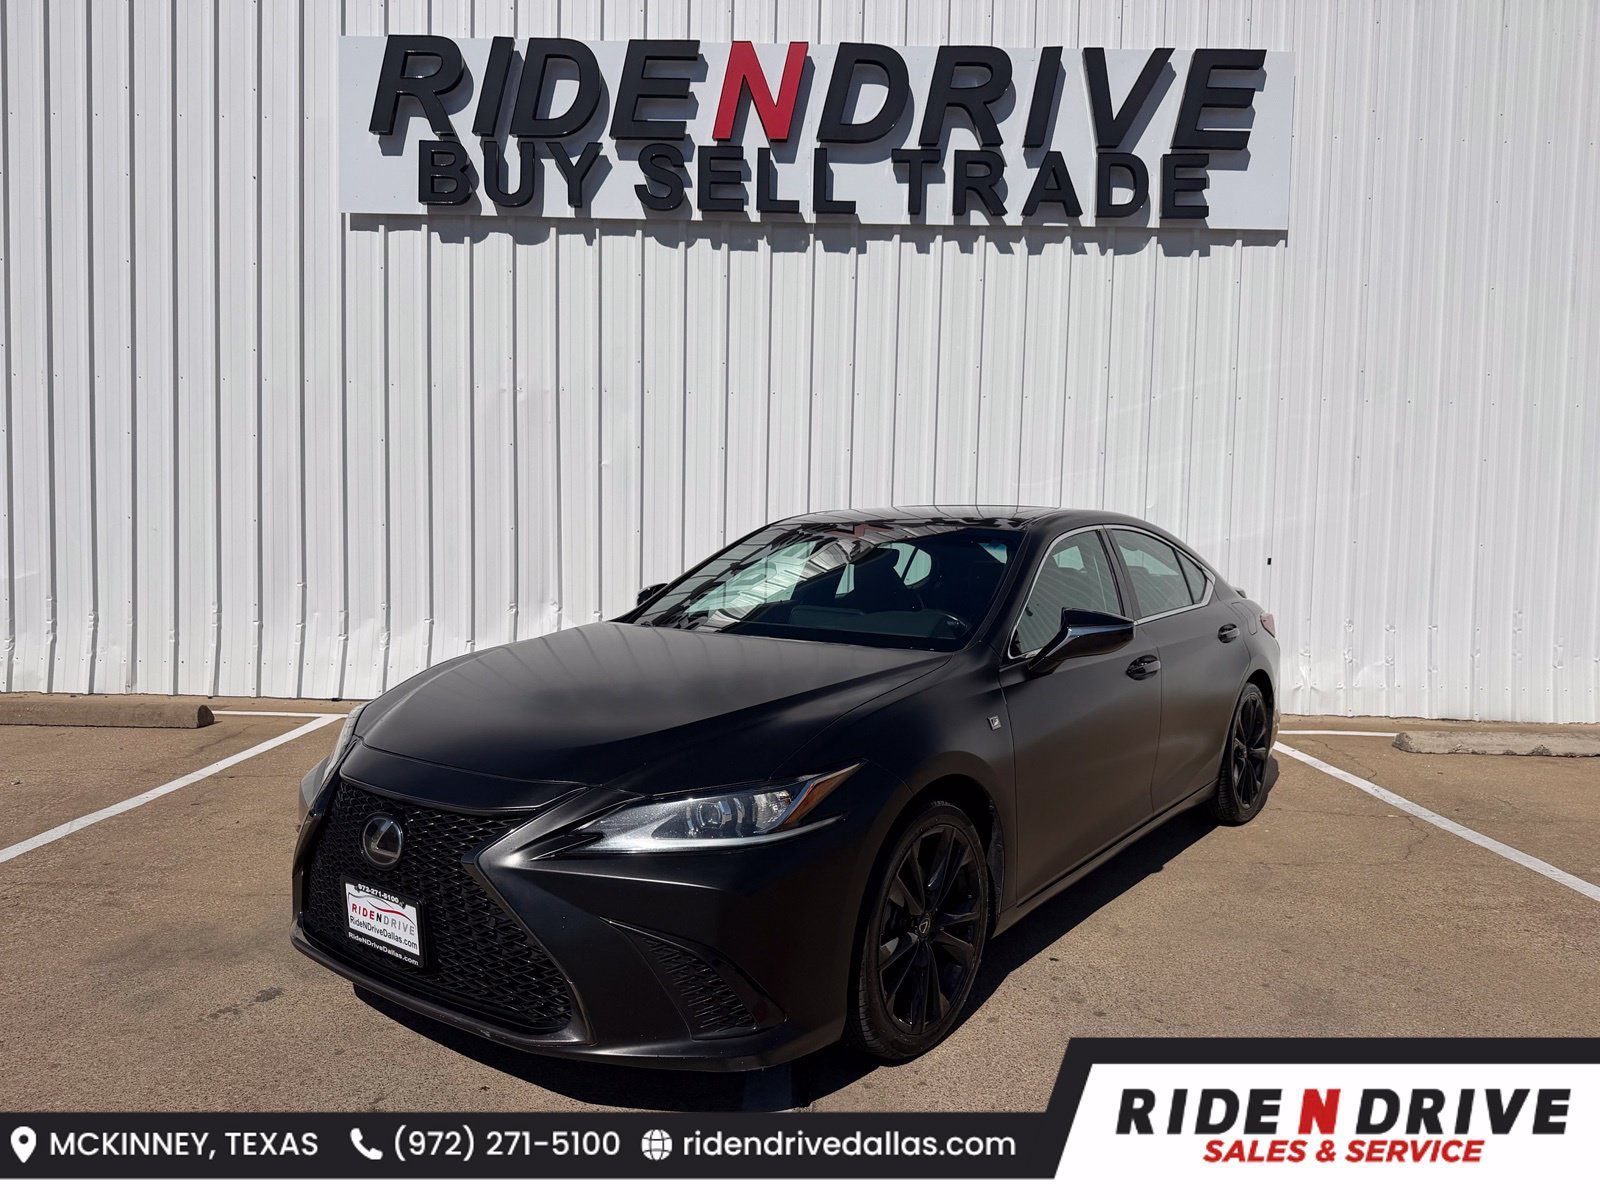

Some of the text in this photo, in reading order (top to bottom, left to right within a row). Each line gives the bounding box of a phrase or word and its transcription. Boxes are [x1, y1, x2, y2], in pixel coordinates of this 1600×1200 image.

[418, 141, 1211, 219] BUY SELL TRADE
[349, 915, 418, 950] RideNDriveDallas.com
[351, 903, 415, 936] RIDENDRIVE
[348, 931, 419, 965] RideNDriveDallas.com
